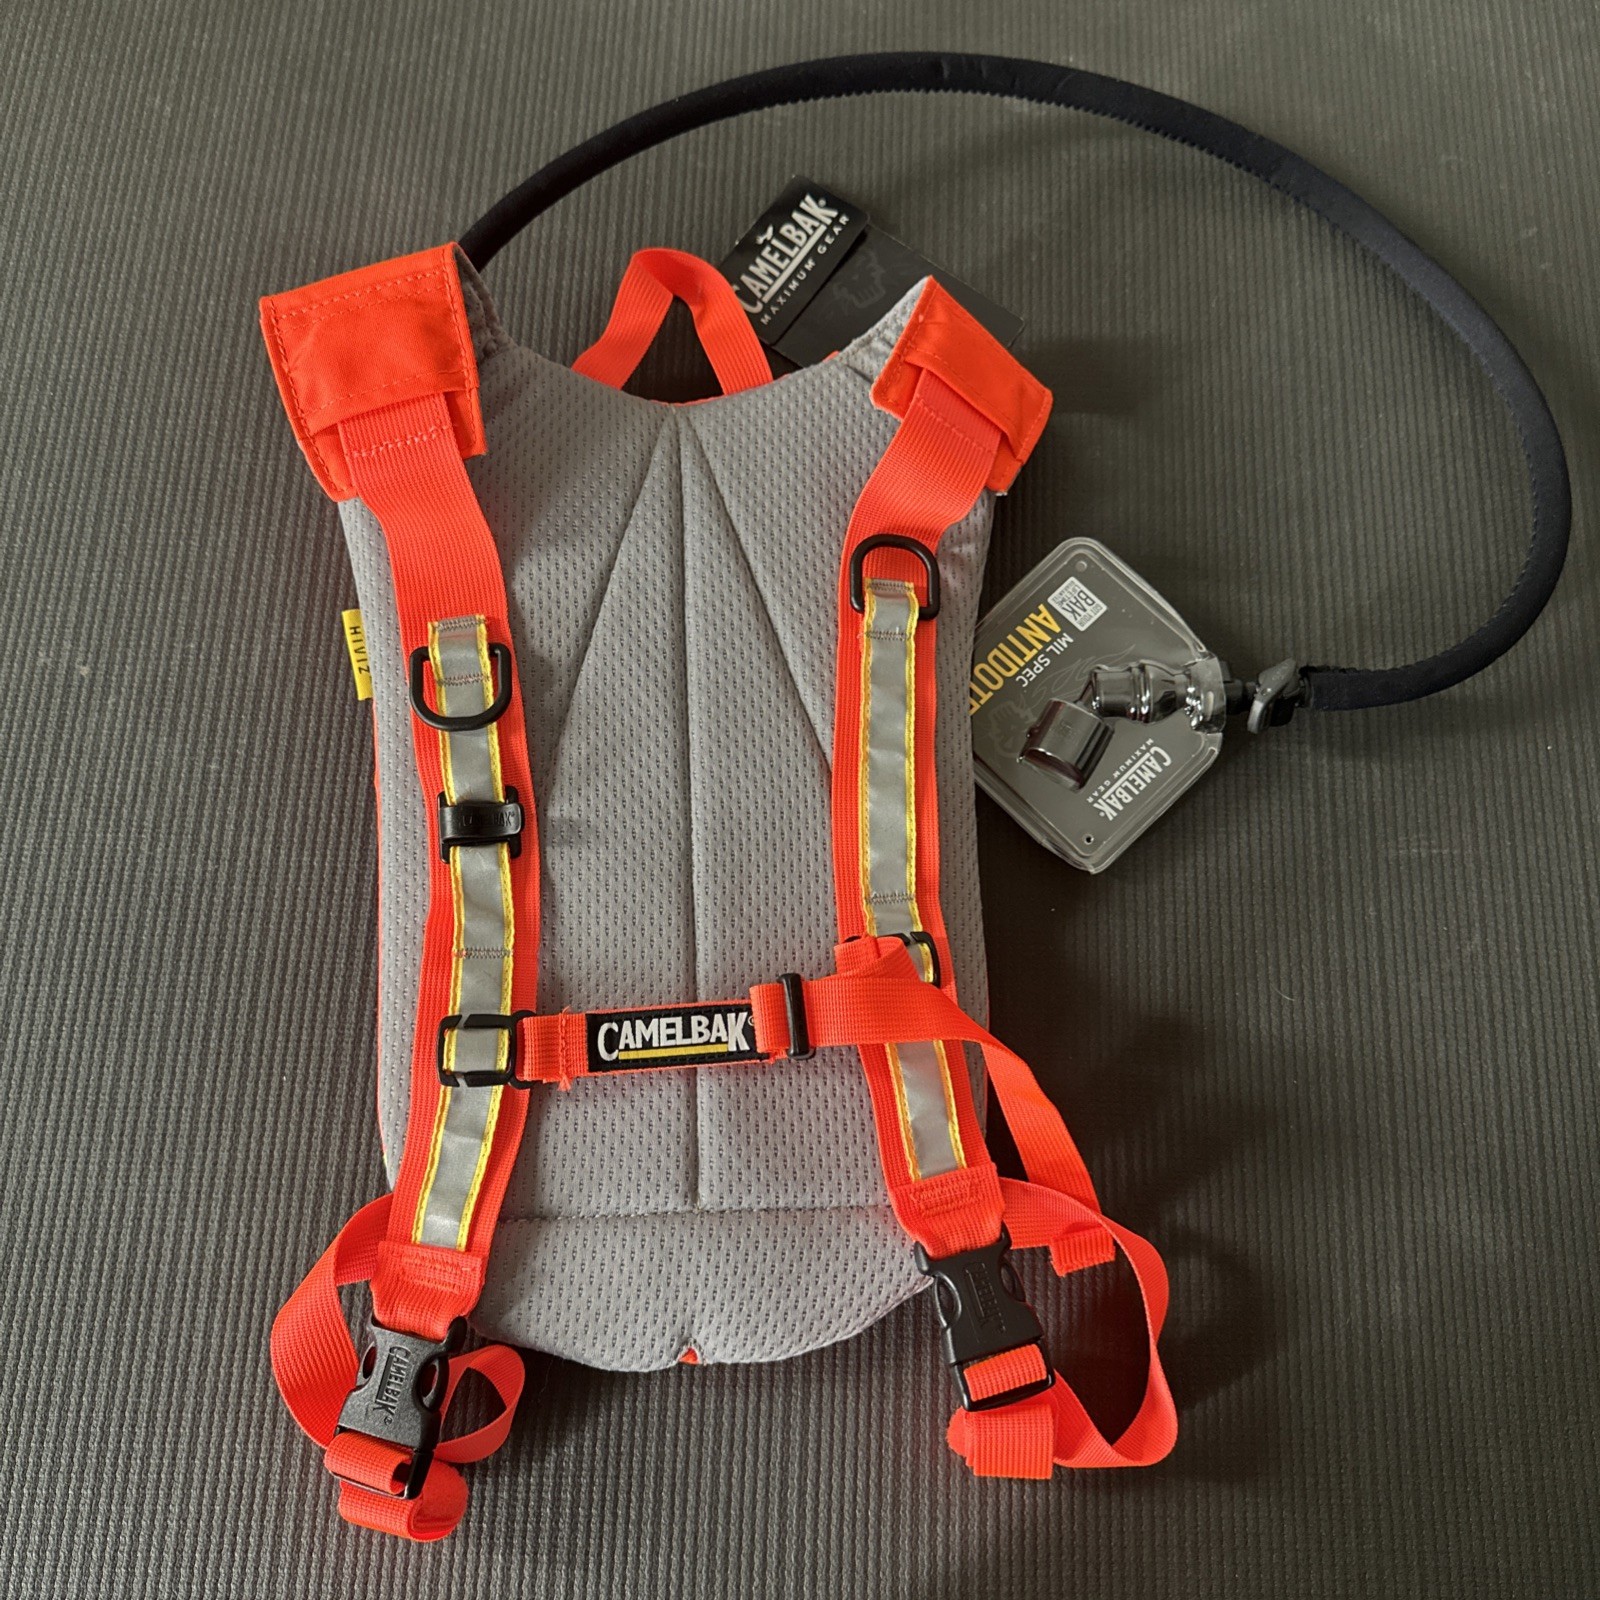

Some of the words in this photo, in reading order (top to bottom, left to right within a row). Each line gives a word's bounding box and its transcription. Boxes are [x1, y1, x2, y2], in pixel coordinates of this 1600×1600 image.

[760, 258, 816, 326] MAXIMUM
[817, 214, 850, 255] GEAR
[1061, 589, 1096, 621] BAK
[1046, 632, 1074, 657] MIL
[1015, 654, 1051, 687] SPEC
[1110, 738, 1154, 777] MAXIMUM
[1086, 780, 1110, 804] GEAR
[1093, 746, 1172, 821] CAMELBAK
[597, 1011, 750, 1062] CAMELBAK
[373, 1345, 411, 1417] CAMELBAK
